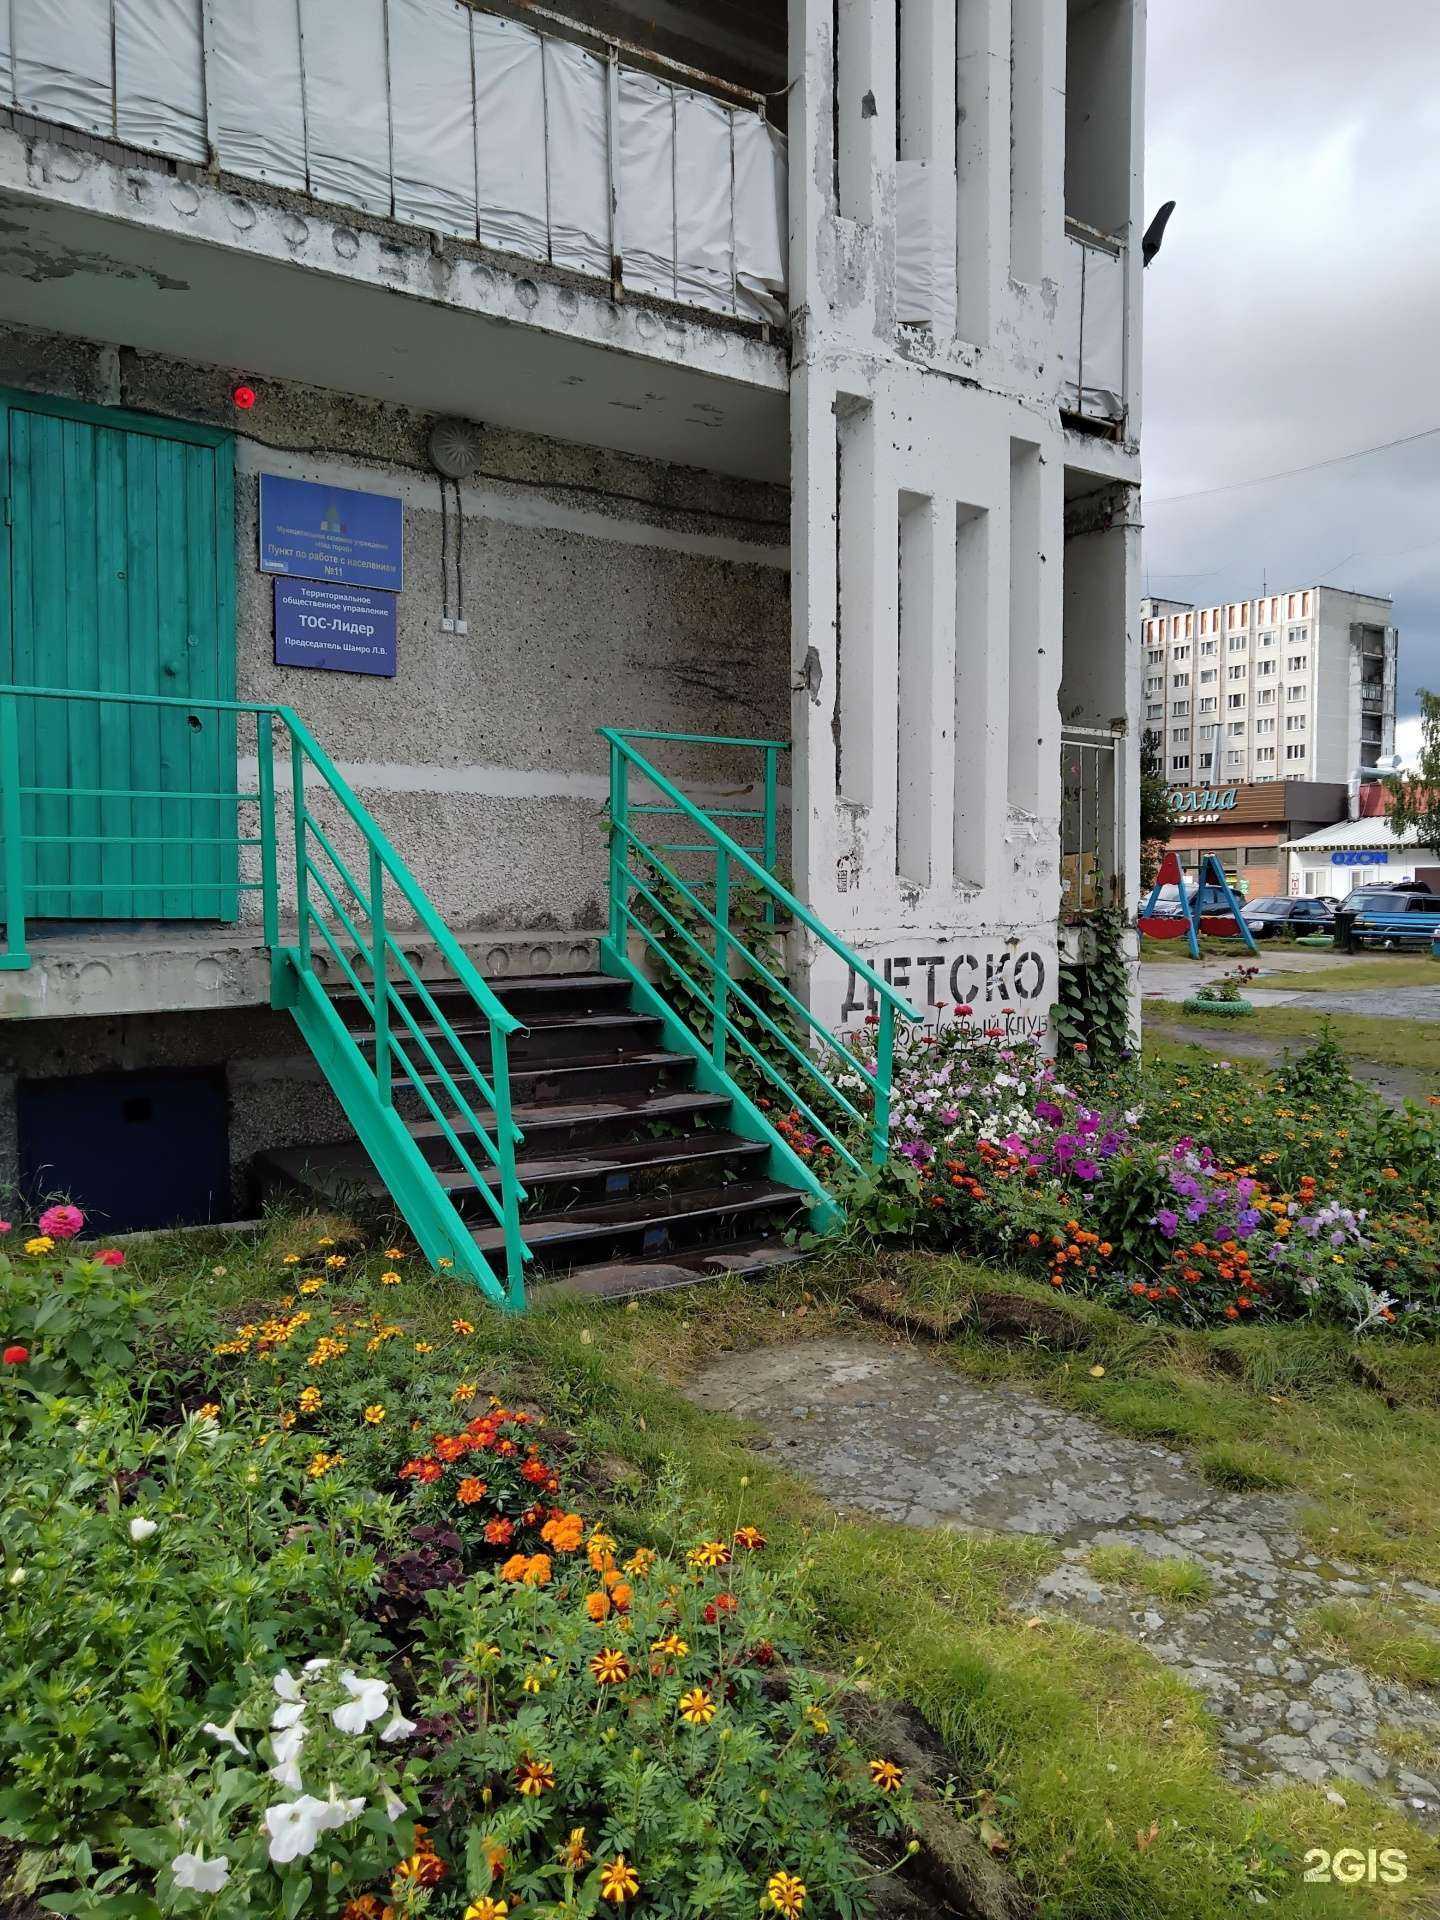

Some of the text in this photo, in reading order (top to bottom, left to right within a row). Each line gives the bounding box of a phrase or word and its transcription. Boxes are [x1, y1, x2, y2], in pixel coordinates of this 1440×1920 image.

[267, 543, 294, 558] Пункт
[295, 550, 307, 560] по
[308, 552, 338, 564] работе
[347, 558, 396, 573] населением
[324, 565, 344, 577] №11
[282, 596, 390, 616] общественное управление
[301, 588, 371, 605] Территориальное
[298, 614, 375, 638] ТОС-Лидер
[284, 636, 342, 651] Председатель
[342, 643, 371, 655] Шамро
[1162, 788, 1238, 812] олна
[1331, 851, 1388, 866] OZON
[841, 951, 1045, 1023] ДЕТСКО
